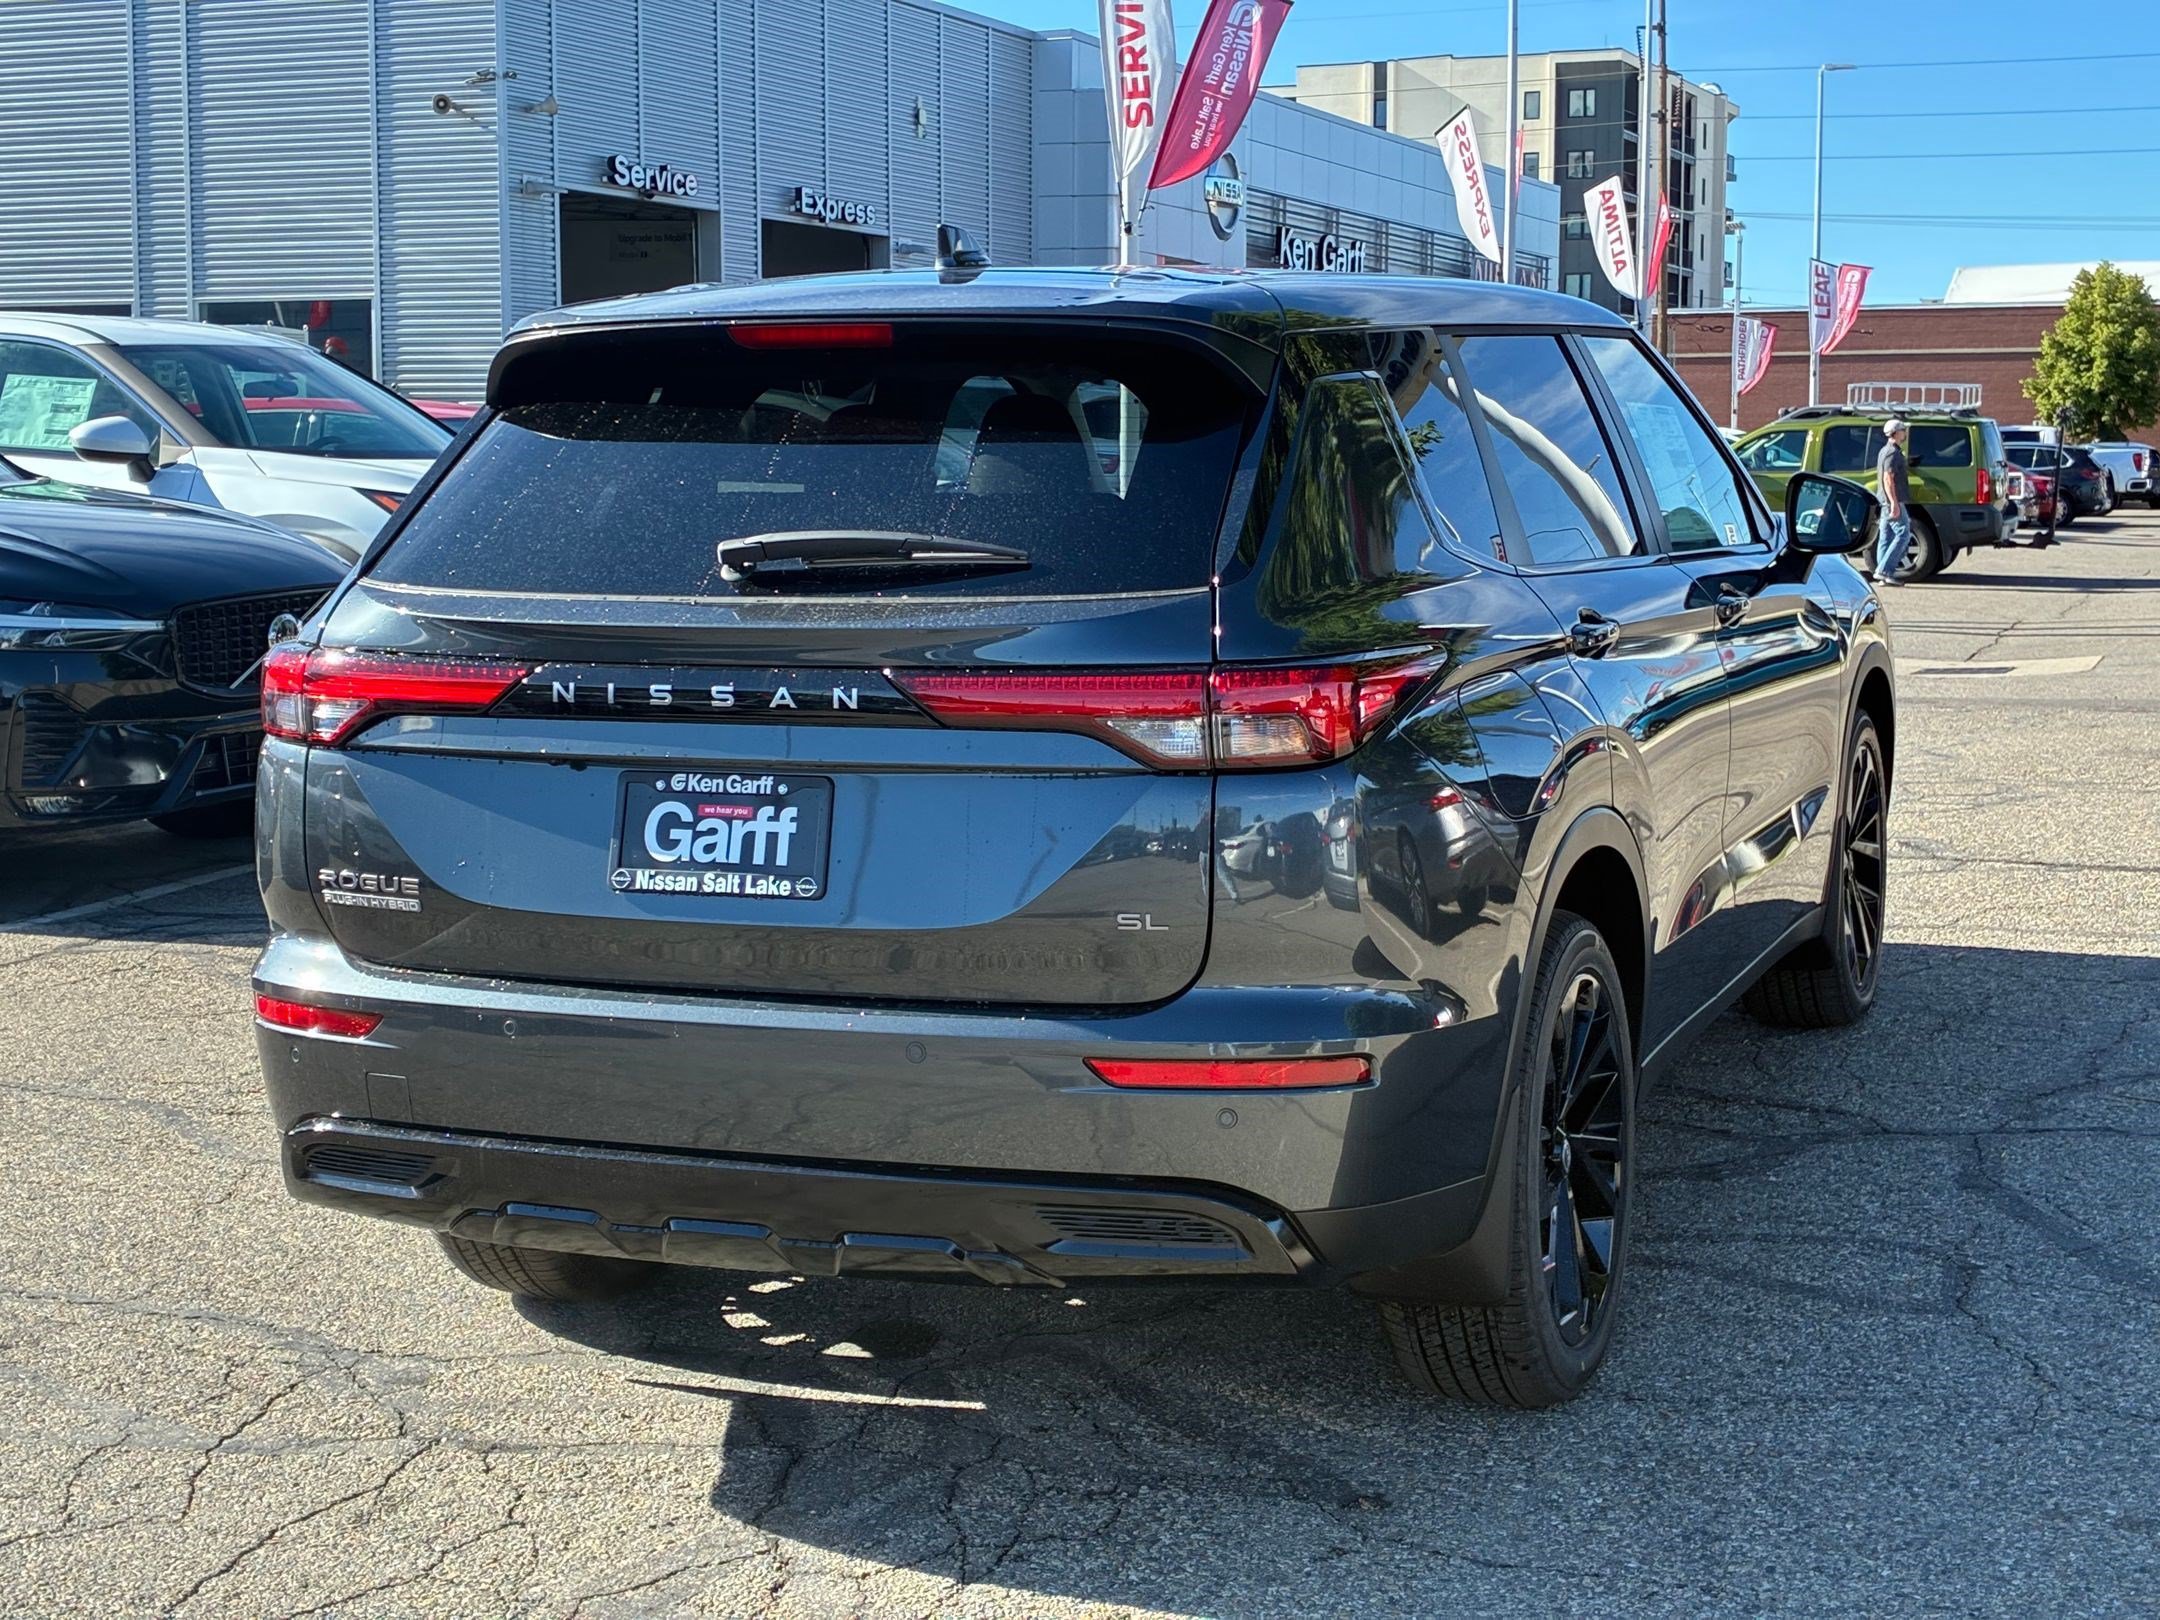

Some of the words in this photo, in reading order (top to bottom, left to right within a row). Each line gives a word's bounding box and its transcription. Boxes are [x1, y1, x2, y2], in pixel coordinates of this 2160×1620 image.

[613, 154, 698, 196] Service
[801, 186, 876, 225] Express
[1280, 226, 1316, 270] Ken
[1322, 234, 1366, 272] Garff
[1814, 264, 1831, 319] LEAF
[1737, 319, 1748, 381] PATHFINDER
[552, 681, 858, 710] NISSAN
[687, 773, 725, 793] Ken
[726, 775, 774, 795] Garff
[716, 806, 733, 814] hear
[733, 808, 748, 816] you
[644, 801, 798, 867] Garff
[318, 868, 420, 896] ROGUE
[635, 869, 698, 892] Nissan
[703, 873, 740, 893] Salt
[745, 875, 791, 896] Lake
[323, 892, 369, 907] PLUG-IN
[370, 898, 419, 911] HYBRID
[1116, 913, 1169, 931] SL
